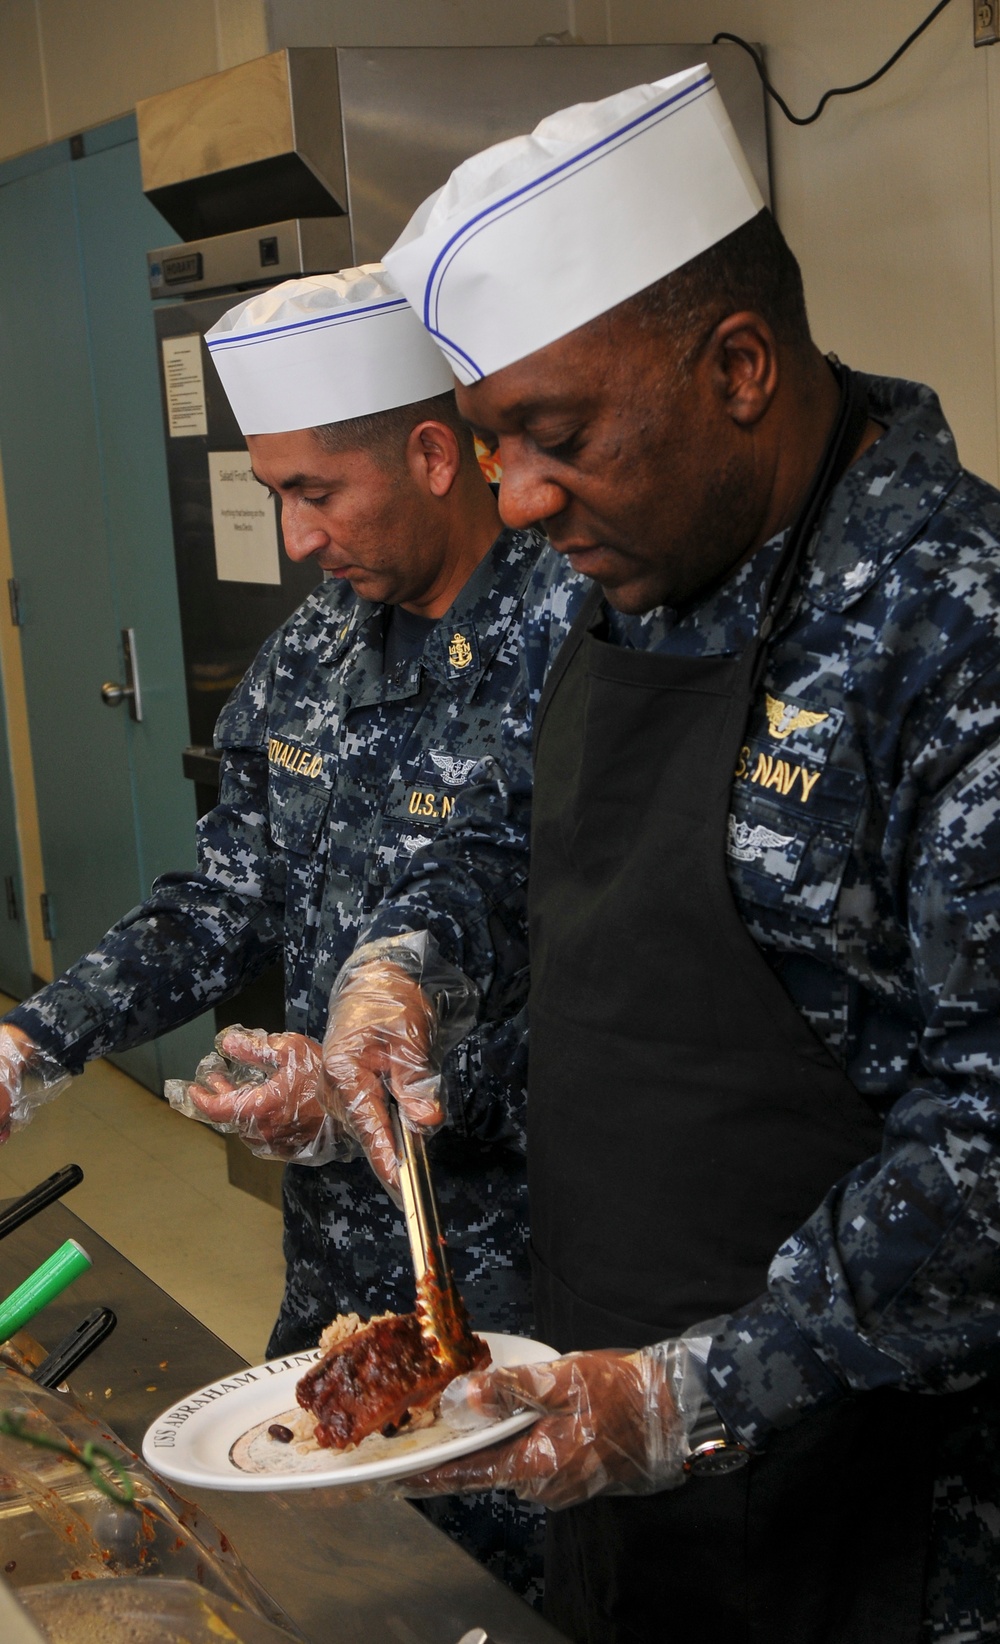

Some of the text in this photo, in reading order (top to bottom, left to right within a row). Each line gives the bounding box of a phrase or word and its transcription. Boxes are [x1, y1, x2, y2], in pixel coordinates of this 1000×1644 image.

[751, 752, 821, 803] NAVY
[409, 791, 439, 817] U.S.
[163, 1372, 260, 1429] ABRAHAM
[153, 1429, 177, 1449] USS
